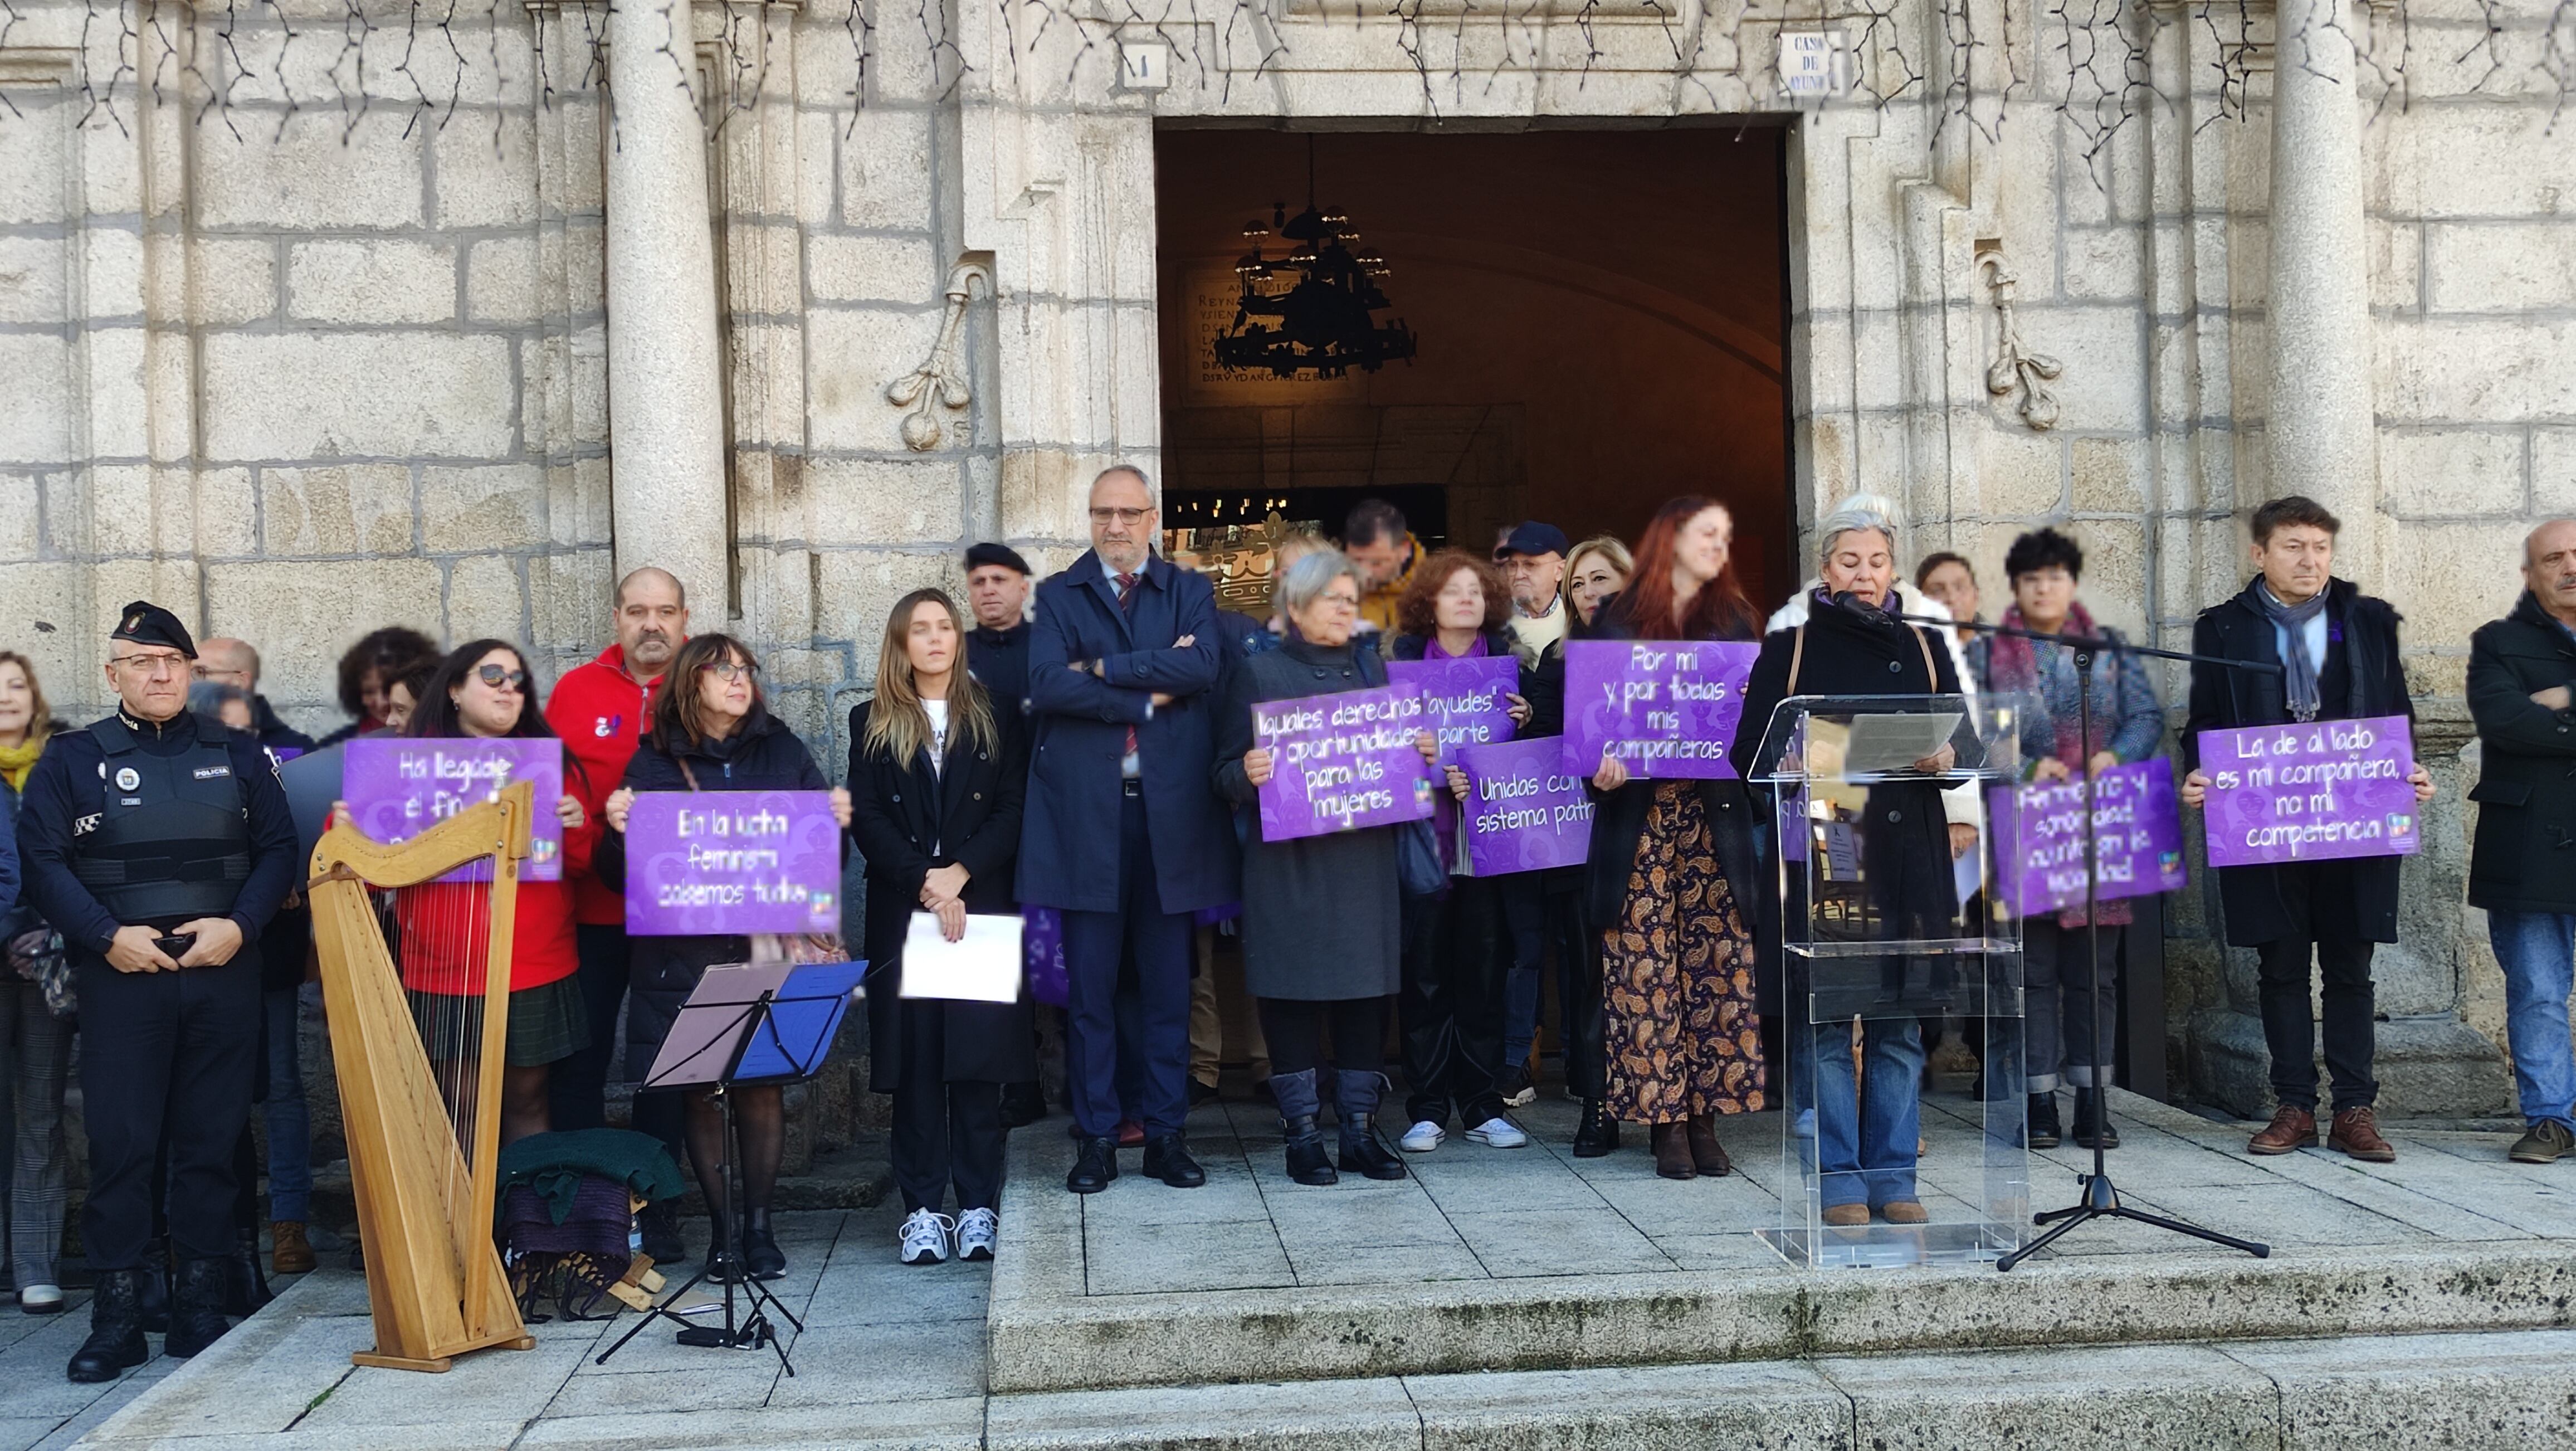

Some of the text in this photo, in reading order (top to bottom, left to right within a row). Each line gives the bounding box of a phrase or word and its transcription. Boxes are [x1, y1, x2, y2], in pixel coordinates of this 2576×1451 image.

[1794, 37, 1823, 51] CASA
[1803, 56, 1818, 70] DE
[1631, 645, 1667, 670] Por
[1603, 674, 1725, 713] y por todas
[1258, 693, 1421, 749] Iguales derechos
[1647, 705, 1679, 729] mis
[1437, 719, 1491, 757] parte
[1602, 733, 1723, 771] compañeras
[2237, 724, 2374, 758] La de al lado
[195, 768, 228, 777] POLICIA
[399, 752, 427, 779] Ha
[1305, 756, 1384, 802] para las
[2216, 753, 2400, 791] es mi compañera,
[1479, 773, 1539, 801] Unidas
[2276, 789, 2334, 815] no mi
[406, 791, 422, 819] el
[430, 790, 464, 817] fin
[1314, 789, 1393, 826] mujeres
[1476, 797, 1596, 836] sistema patr
[679, 809, 704, 836] En
[713, 809, 728, 836] la
[2246, 816, 2380, 857] competencia
